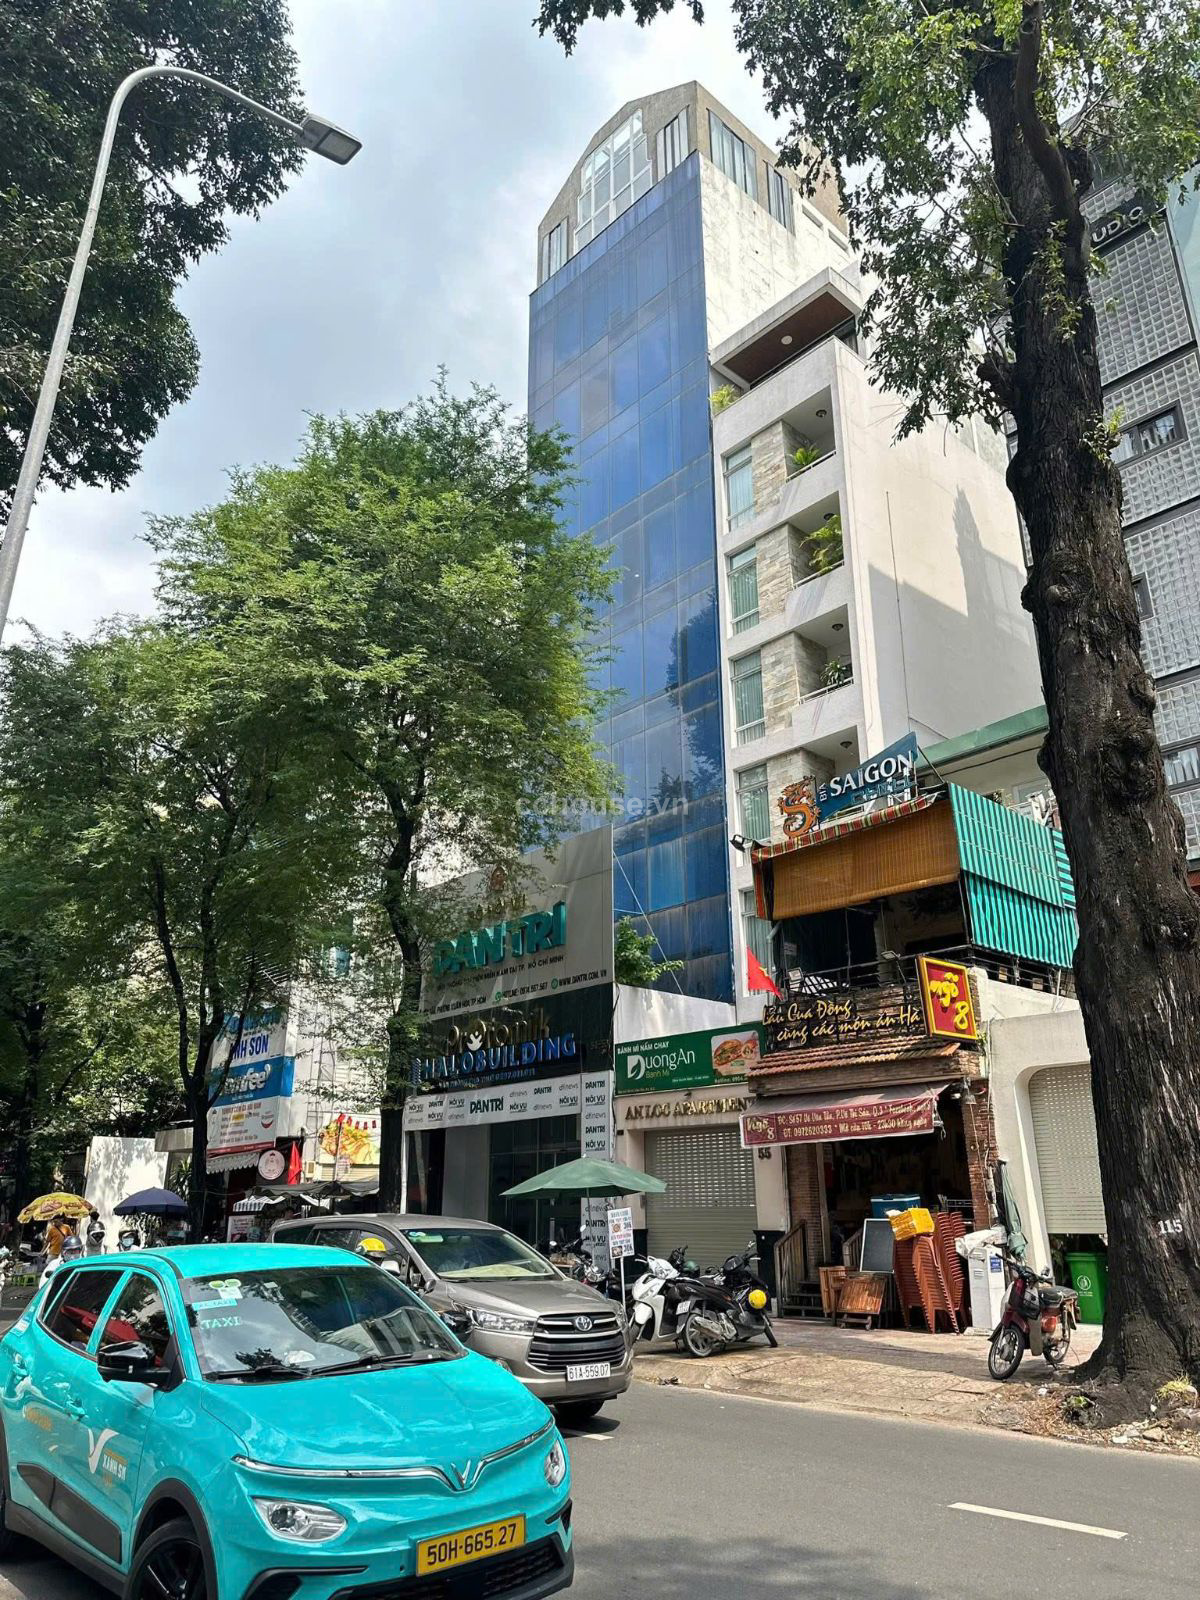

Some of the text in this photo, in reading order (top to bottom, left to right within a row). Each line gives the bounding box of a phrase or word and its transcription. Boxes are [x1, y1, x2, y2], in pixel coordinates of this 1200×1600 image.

[788, 1003, 813, 1021] Cua
[816, 1000, 851, 1019] Đồng
[954, 1001, 969, 1030] 8
[777, 1025, 808, 1044] cùng
[812, 1020, 834, 1036] các
[839, 1015, 870, 1032] món
[758, 1147, 771, 1160] 55
[569, 1363, 609, 1380] 61A-559.07
[427, 1523, 517, 1566] 50H-665.27
